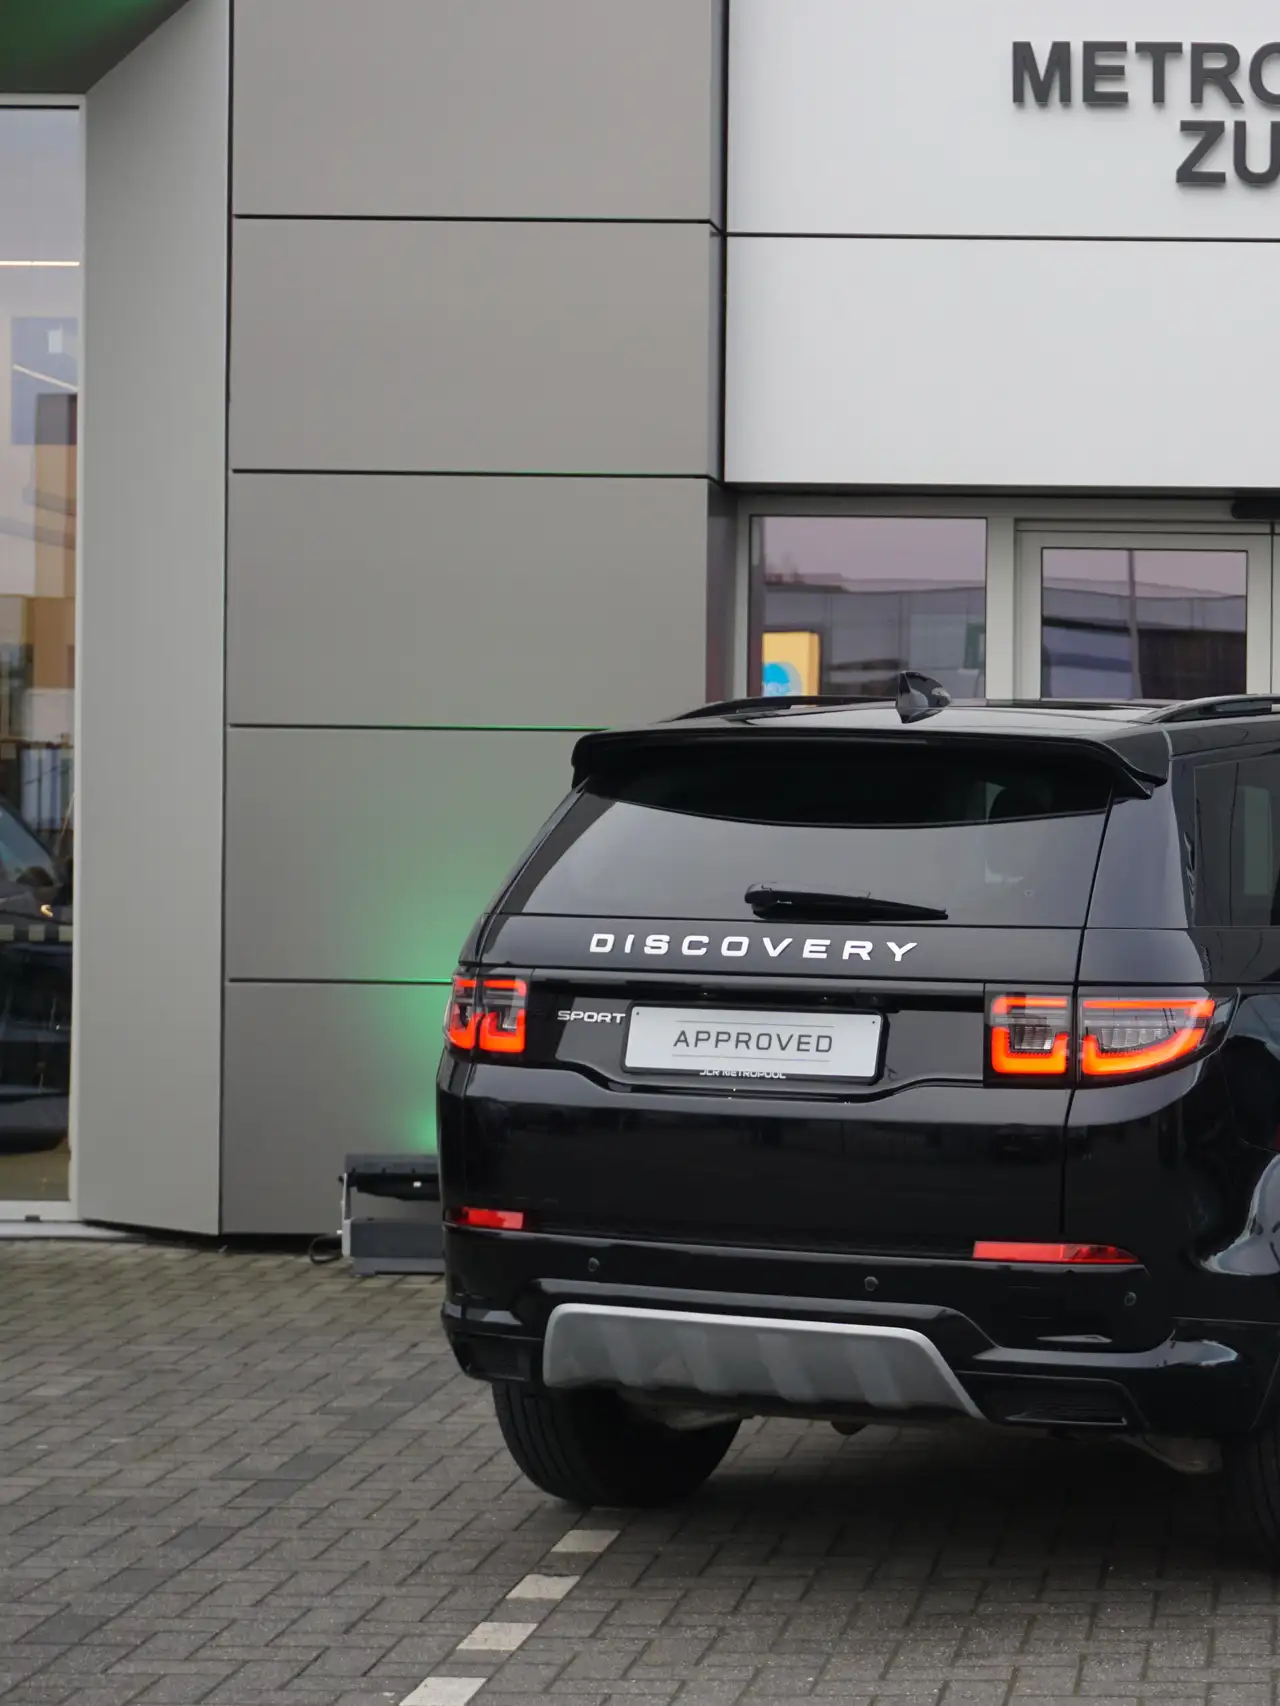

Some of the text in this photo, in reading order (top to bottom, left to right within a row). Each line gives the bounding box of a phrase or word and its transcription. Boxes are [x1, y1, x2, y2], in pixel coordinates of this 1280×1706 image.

[588, 933, 918, 963] DISCOVERY
[556, 1009, 627, 1024] SPORT
[672, 1029, 834, 1054] APPROVED
[721, 1068, 787, 1080] METROPOOL
